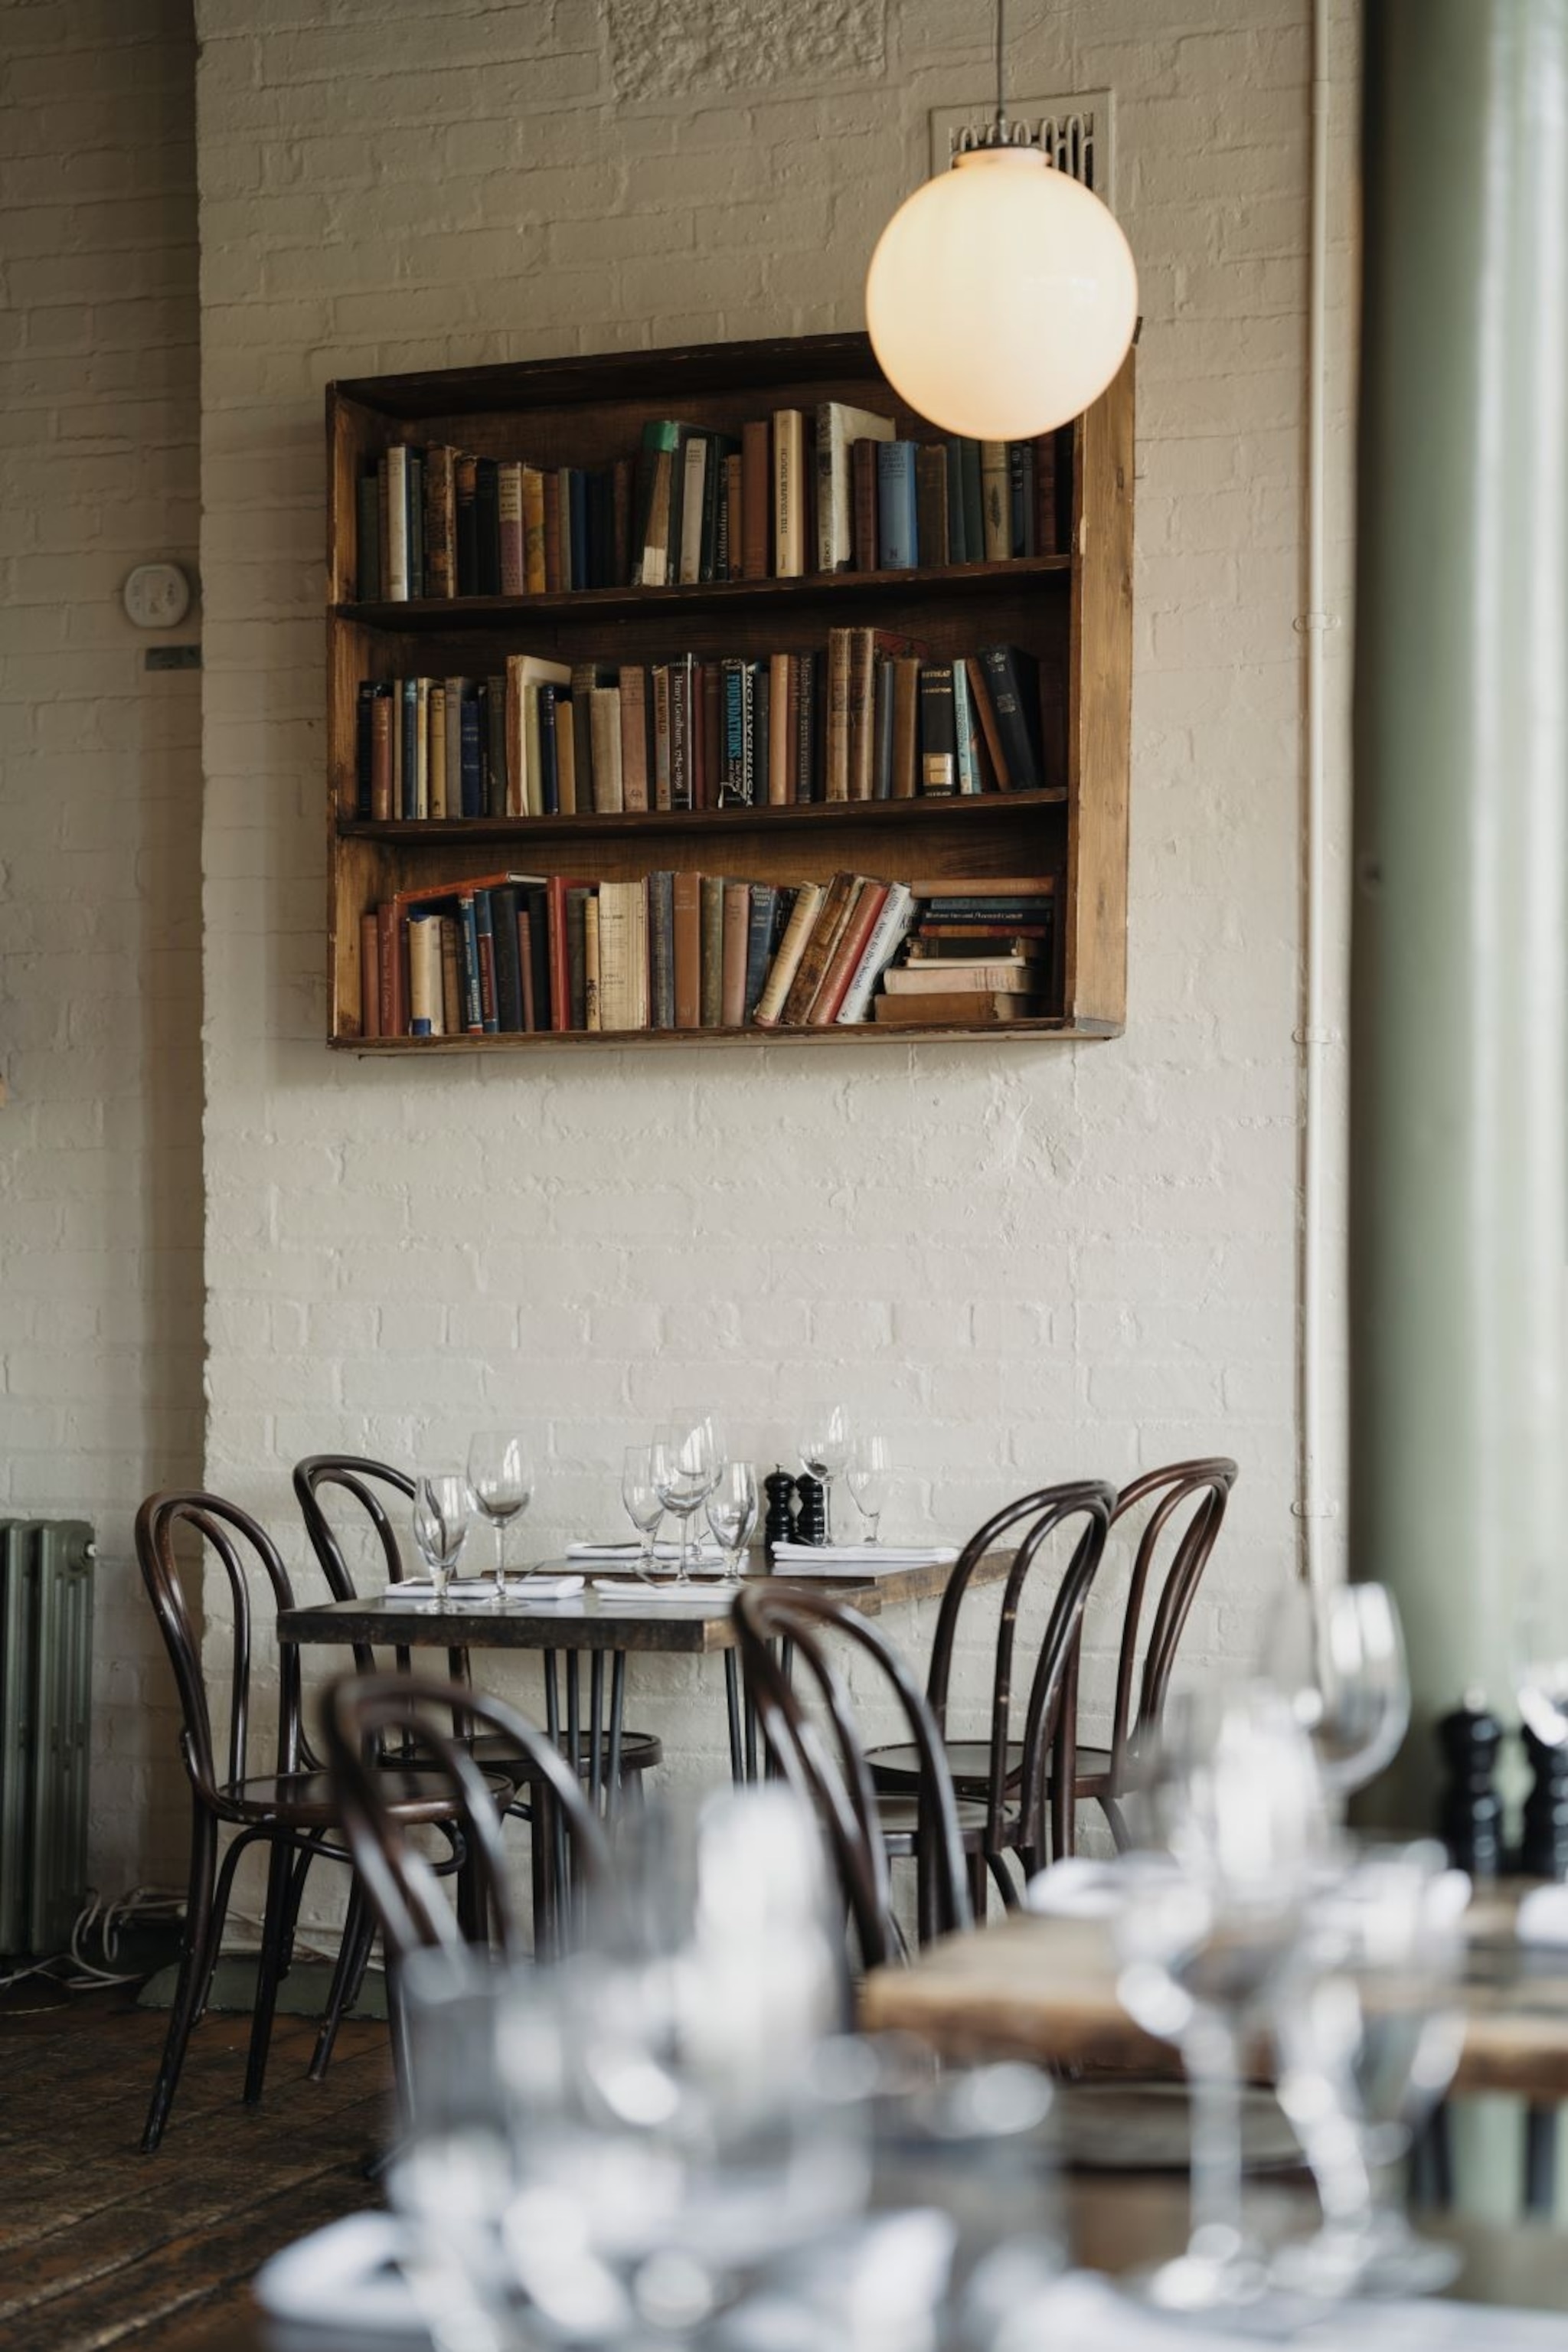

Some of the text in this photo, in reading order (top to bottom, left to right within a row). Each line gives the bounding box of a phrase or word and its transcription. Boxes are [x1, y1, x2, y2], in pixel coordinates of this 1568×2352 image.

[779, 448, 788, 479] TOUCH
[779, 518, 788, 534] THE
[673, 675, 684, 702] Henry
[727, 674, 742, 759] FOUNDATIONS
